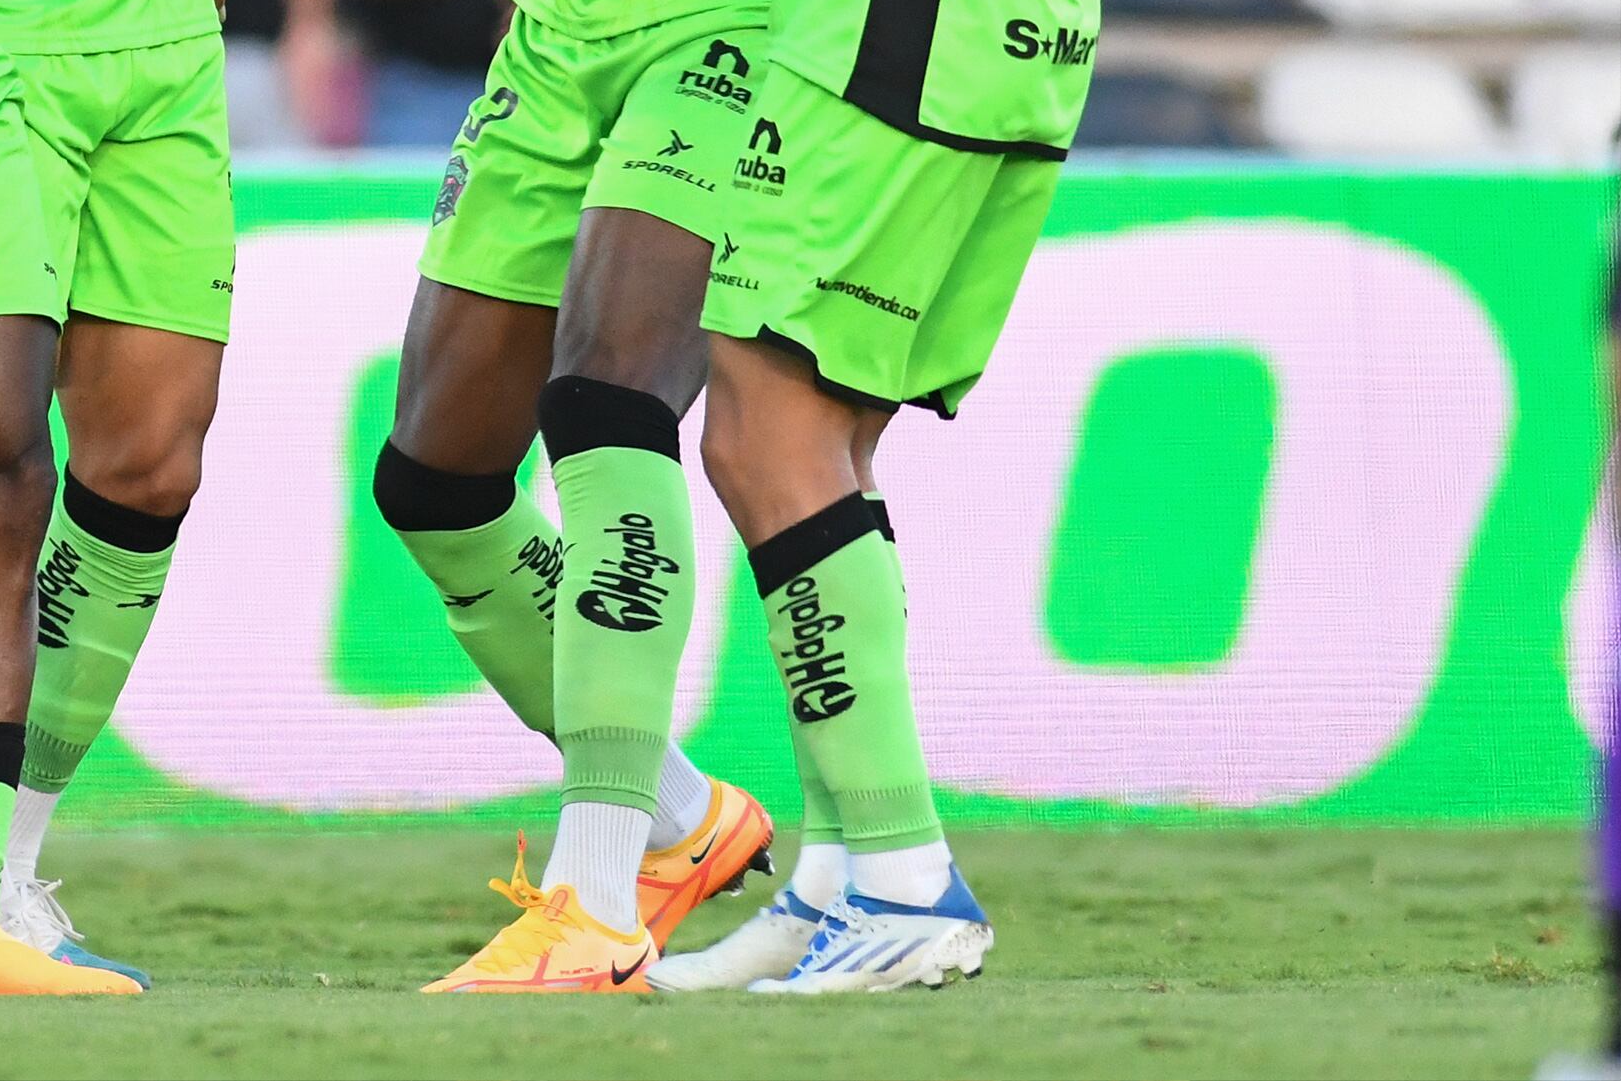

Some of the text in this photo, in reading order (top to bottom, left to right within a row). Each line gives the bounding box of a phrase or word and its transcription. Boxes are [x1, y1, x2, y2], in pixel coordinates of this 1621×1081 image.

[679, 71, 752, 106] ruba
[622, 160, 716, 193] SPORELLI
[590, 513, 680, 605] Hágalo
[777, 577, 846, 690] Hágalo
